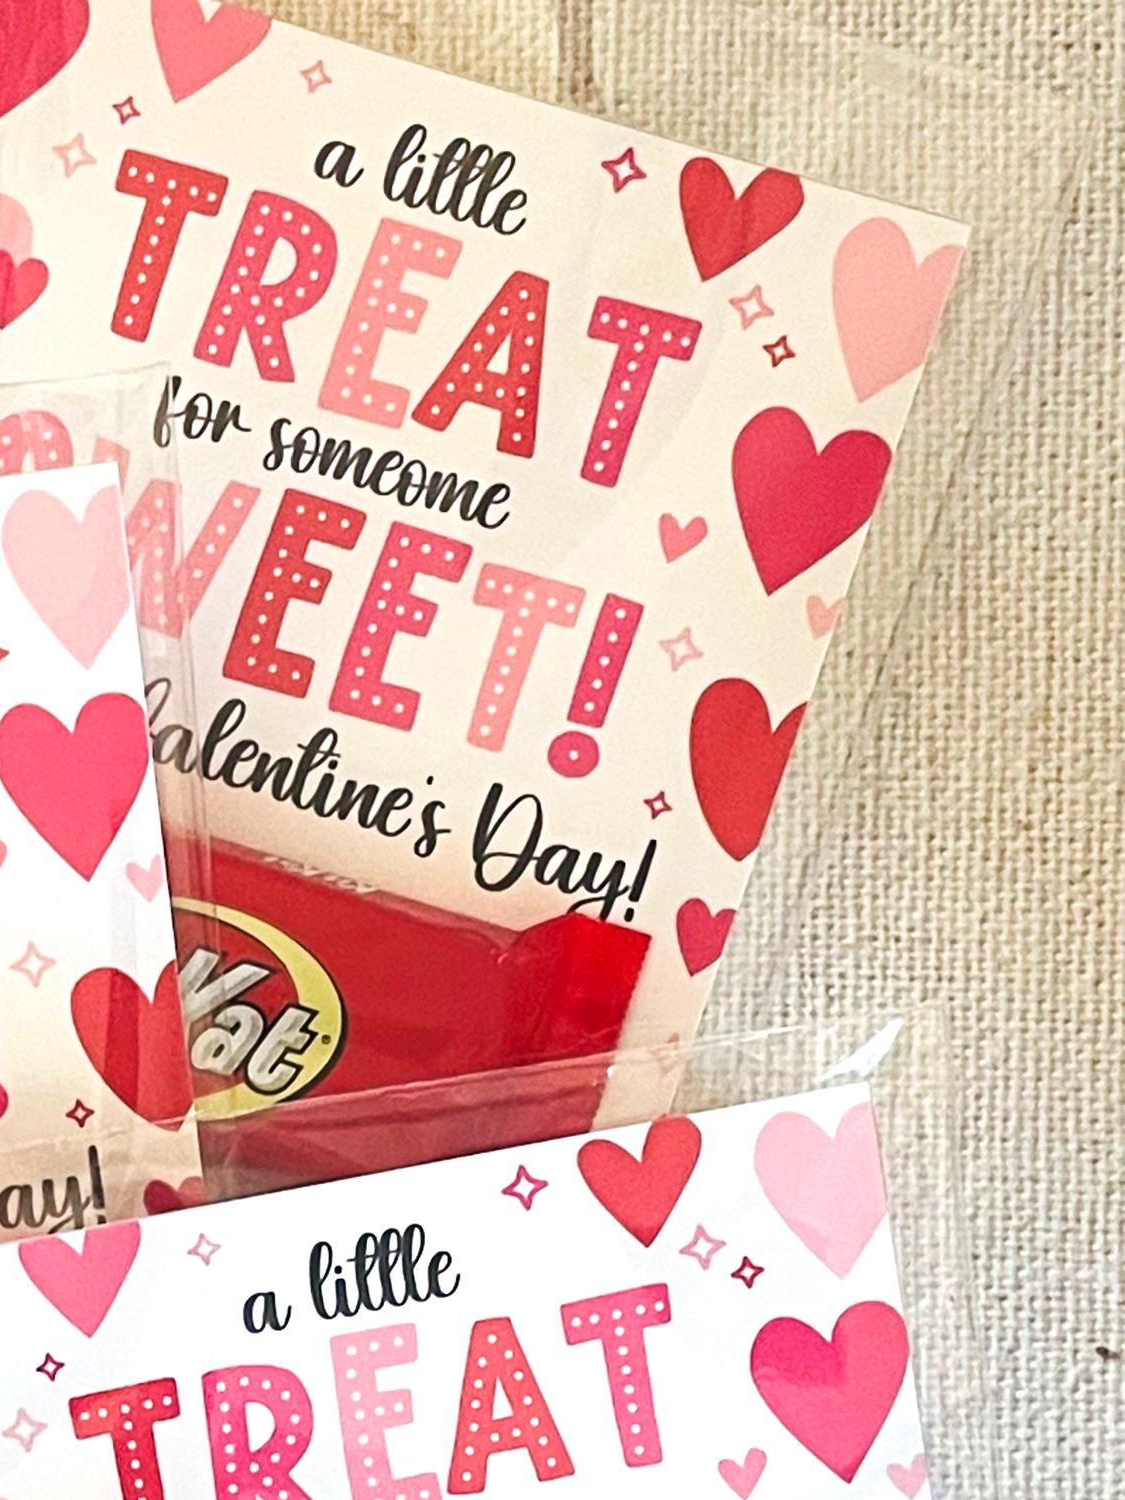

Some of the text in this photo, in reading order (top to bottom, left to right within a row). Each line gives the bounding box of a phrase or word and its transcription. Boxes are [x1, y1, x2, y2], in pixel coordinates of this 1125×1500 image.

[313, 123, 528, 236] a little
[111, 148, 701, 489] TREAT
[153, 375, 252, 449] for
[473, 782, 658, 923] Day!
[243, 1223, 462, 1334] a little
